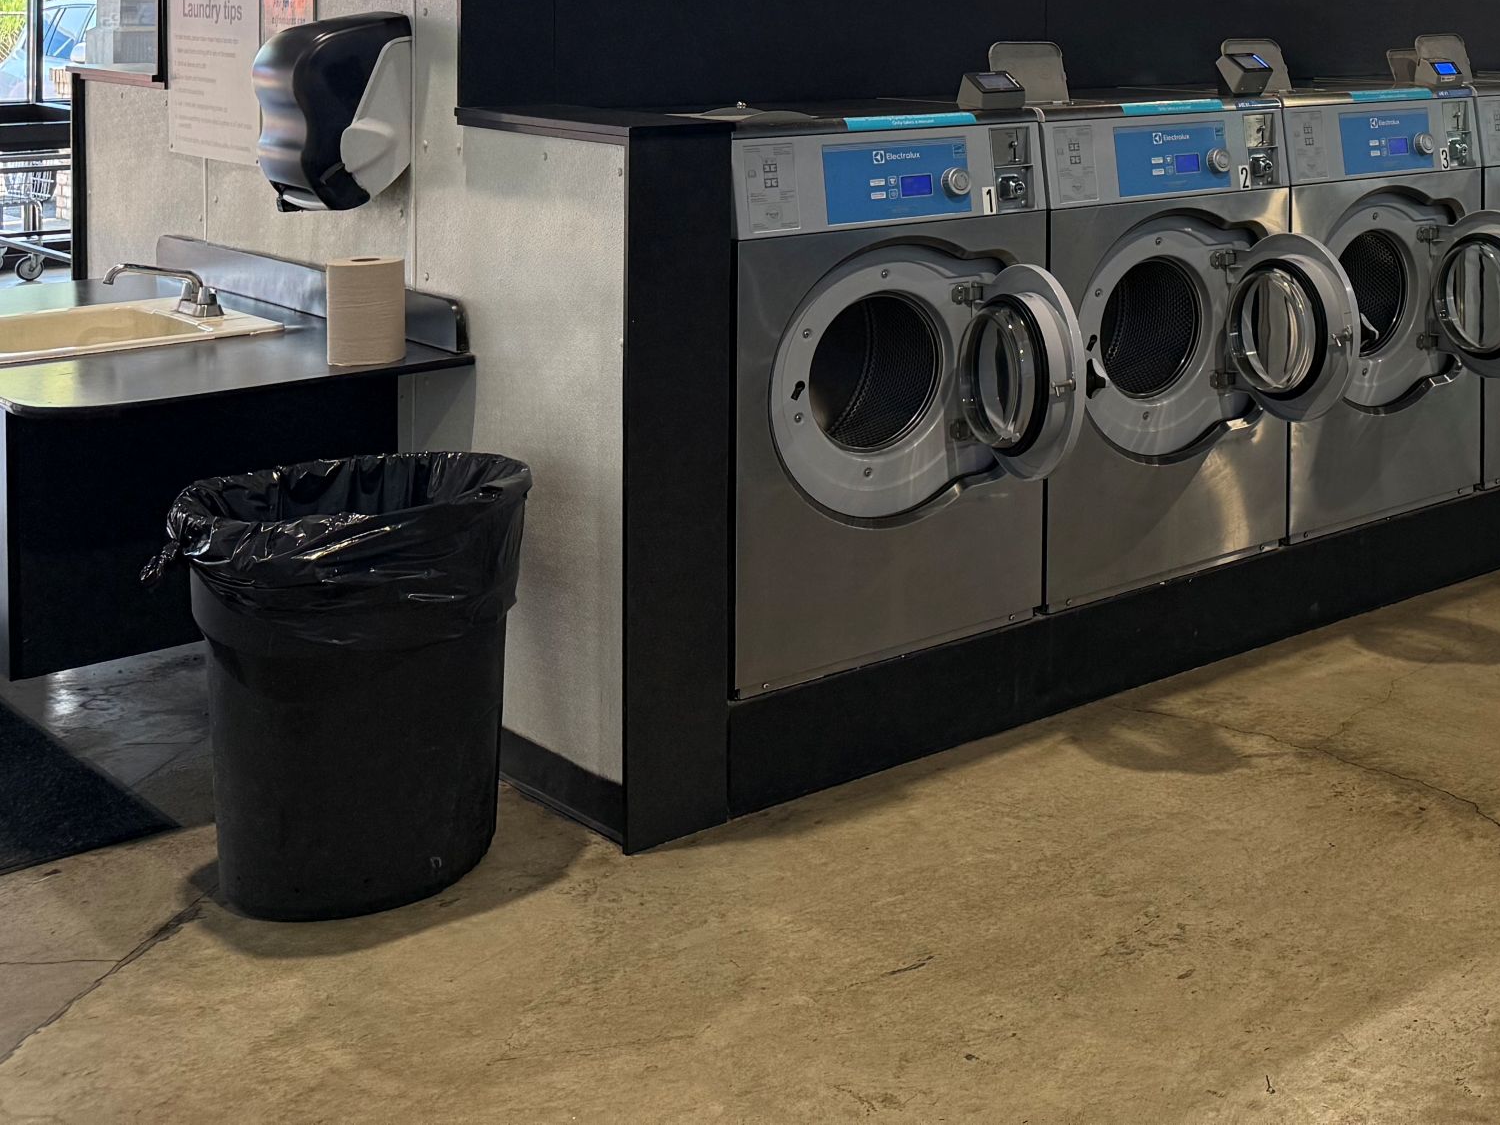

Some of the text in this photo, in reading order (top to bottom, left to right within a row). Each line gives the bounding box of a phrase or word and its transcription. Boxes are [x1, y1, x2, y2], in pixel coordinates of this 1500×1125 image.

[223, 0, 243, 25] tips
[1163, 133, 1190, 141] Electrolux
[886, 151, 920, 161] Electrolux
[1442, 150, 1449, 169] 3
[1241, 167, 1250, 189] 2
[986, 189, 993, 213] 1
